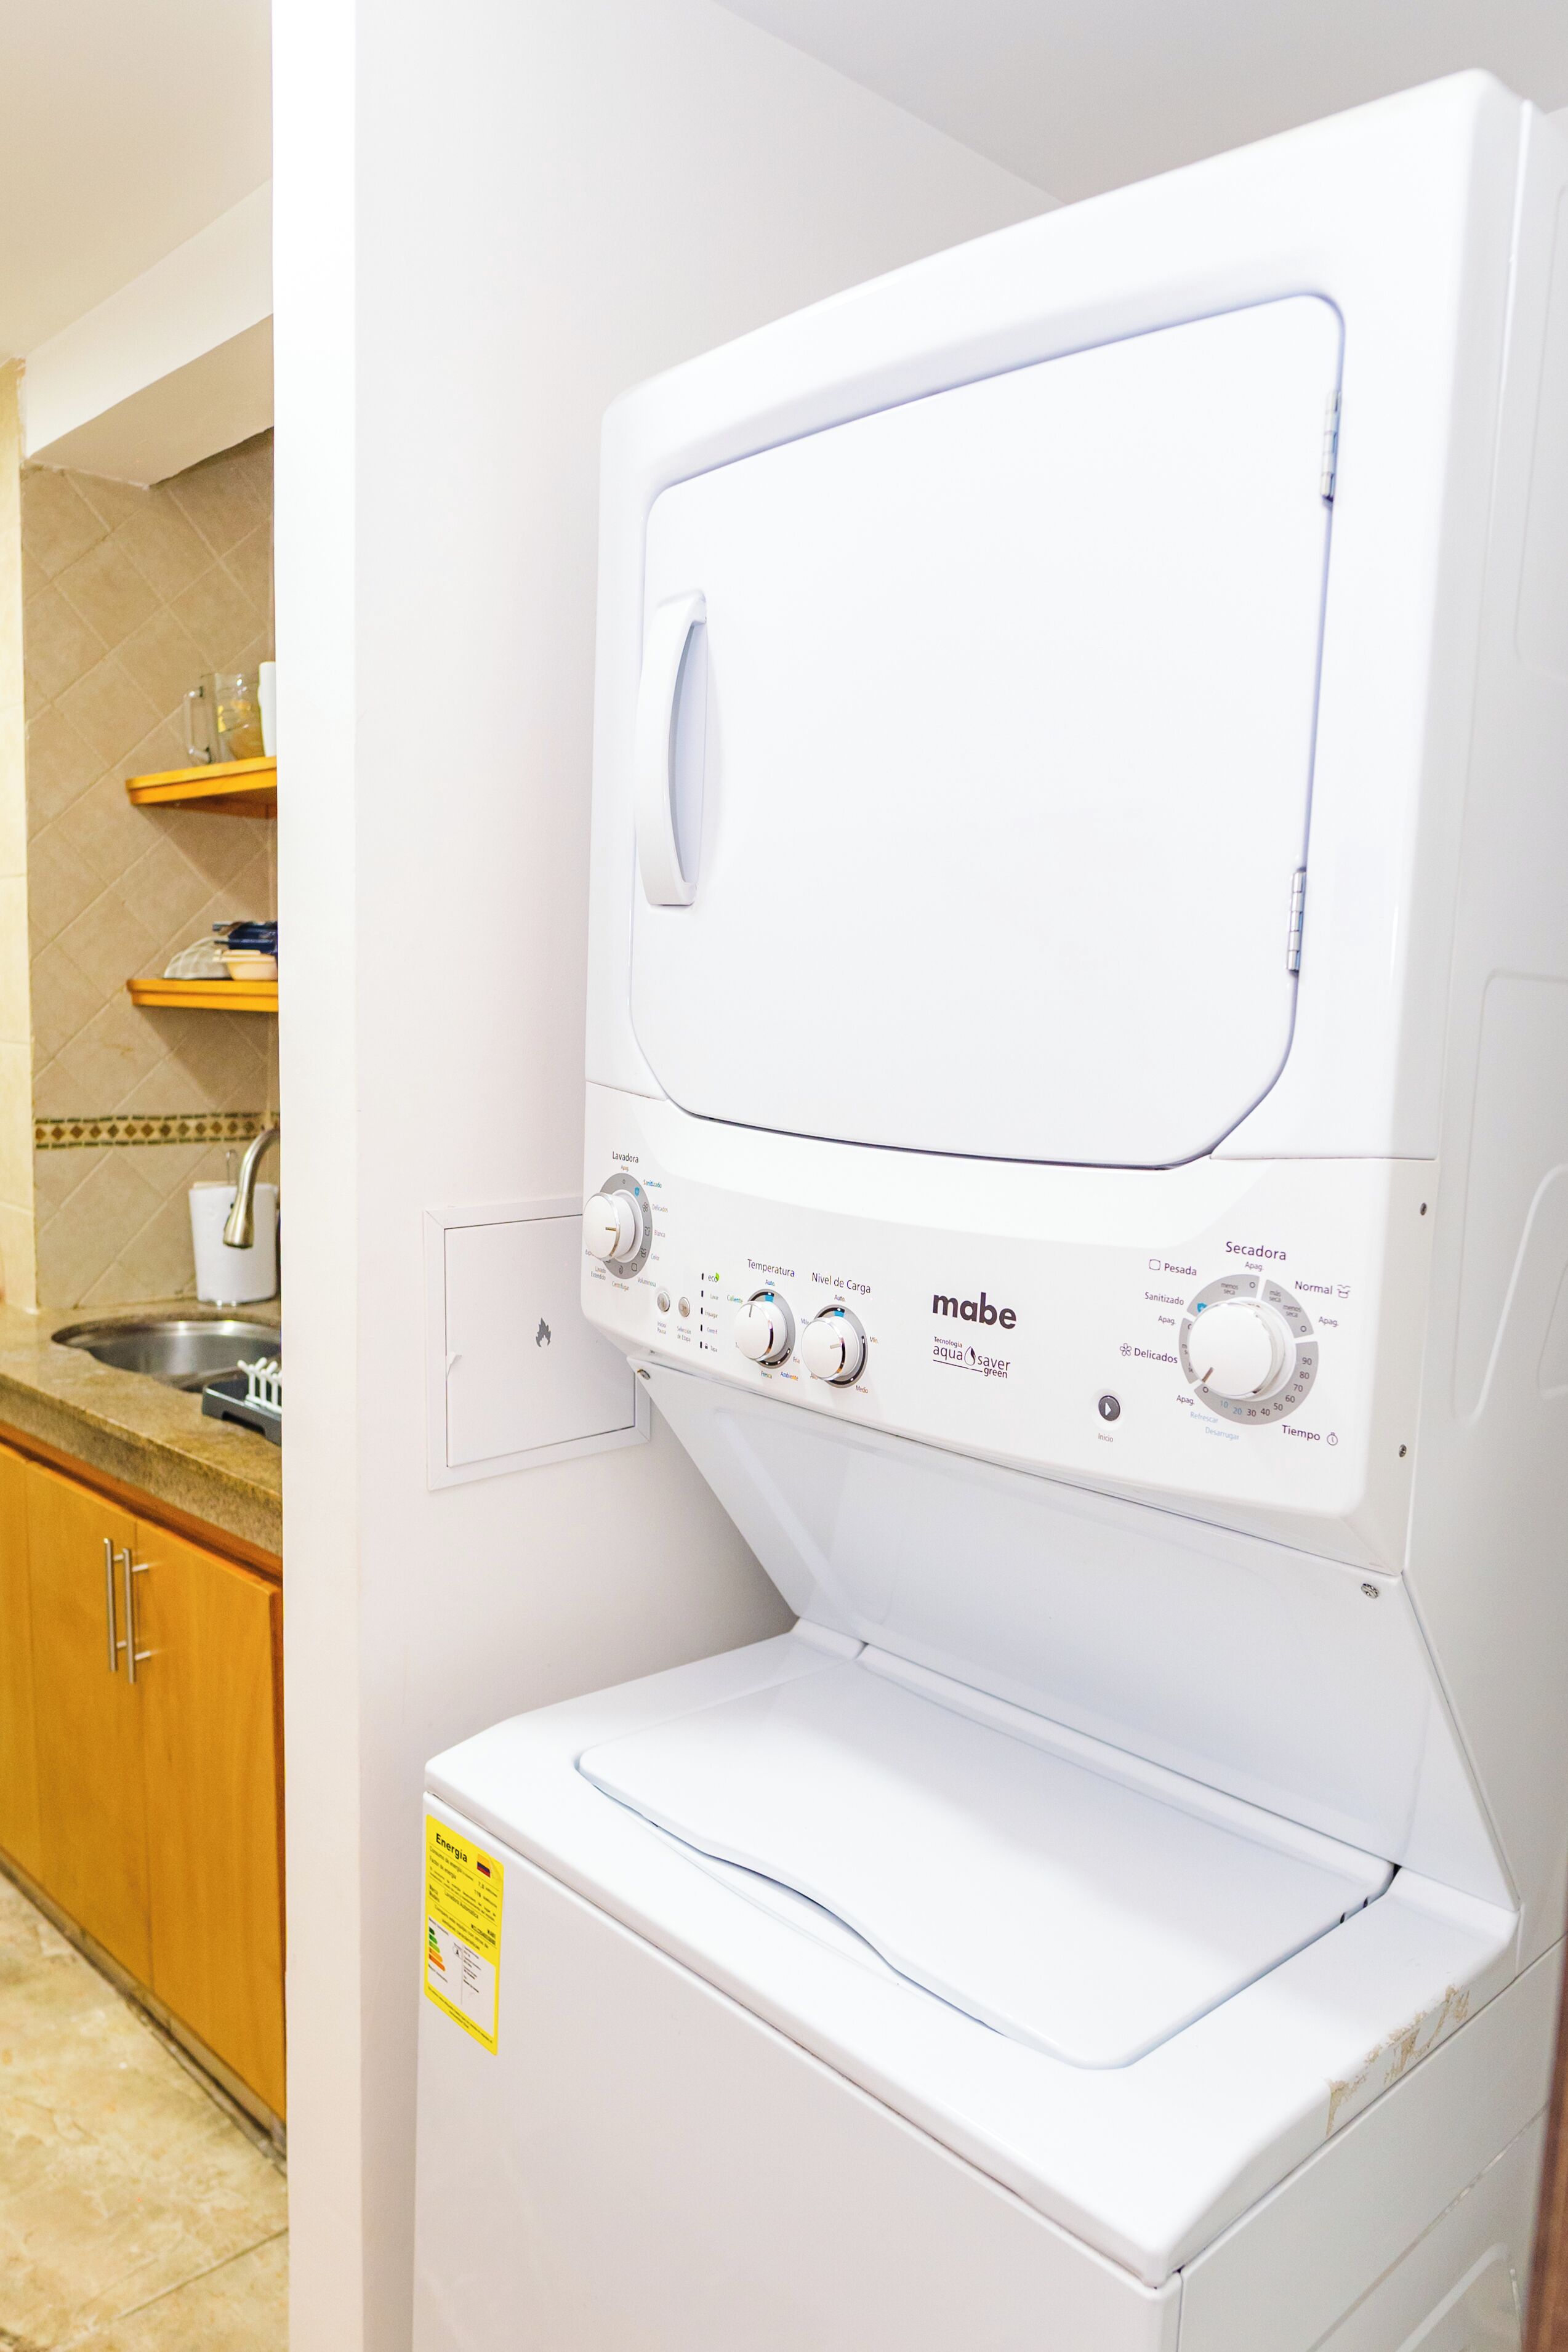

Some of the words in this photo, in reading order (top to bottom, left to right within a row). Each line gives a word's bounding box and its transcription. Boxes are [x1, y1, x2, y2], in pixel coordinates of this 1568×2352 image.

[612, 1151, 639, 1163] Lavadora
[643, 1179, 662, 1188] Sanitizado
[1226, 1241, 1287, 1260] Secadora
[747, 1259, 795, 1278] Temperatura
[1164, 1263, 1197, 1276] Pesada
[1245, 1262, 1264, 1272] Apag.
[708, 1275, 718, 1283] eco
[811, 1272, 832, 1285] Nivel
[834, 1277, 844, 1288] de
[846, 1279, 870, 1295] Carga
[1221, 1282, 1239, 1291] menos
[1295, 1281, 1333, 1295] Normal
[1145, 1292, 1184, 1305] Sanitizado
[933, 1292, 1016, 1329] mabe
[1282, 1304, 1302, 1313] menos
[1157, 1315, 1176, 1326] Apag.
[1319, 1316, 1340, 1327] Apag.
[933, 1345, 963, 1361] aqua
[978, 1355, 1011, 1371] saver
[1134, 1347, 1178, 1364] Delicados
[1301, 1356, 1313, 1366] 90
[781, 1371, 799, 1381] Ambiente
[984, 1367, 1008, 1379] green
[1299, 1371, 1310, 1380] 80
[1293, 1383, 1304, 1392] 70
[1176, 1395, 1195, 1406] Apag.
[1220, 1400, 1229, 1409] 10
[1285, 1395, 1296, 1403] 60
[1232, 1406, 1243, 1415] 20
[1260, 1408, 1271, 1416] 40
[1273, 1402, 1284, 1411] 50
[1190, 1411, 1219, 1424] Refrescar
[1247, 1408, 1256, 1417] 30
[1098, 1433, 1114, 1443] Inicio
[1205, 1427, 1240, 1441] Desarrugar
[1282, 1424, 1321, 1441] Tiempo
